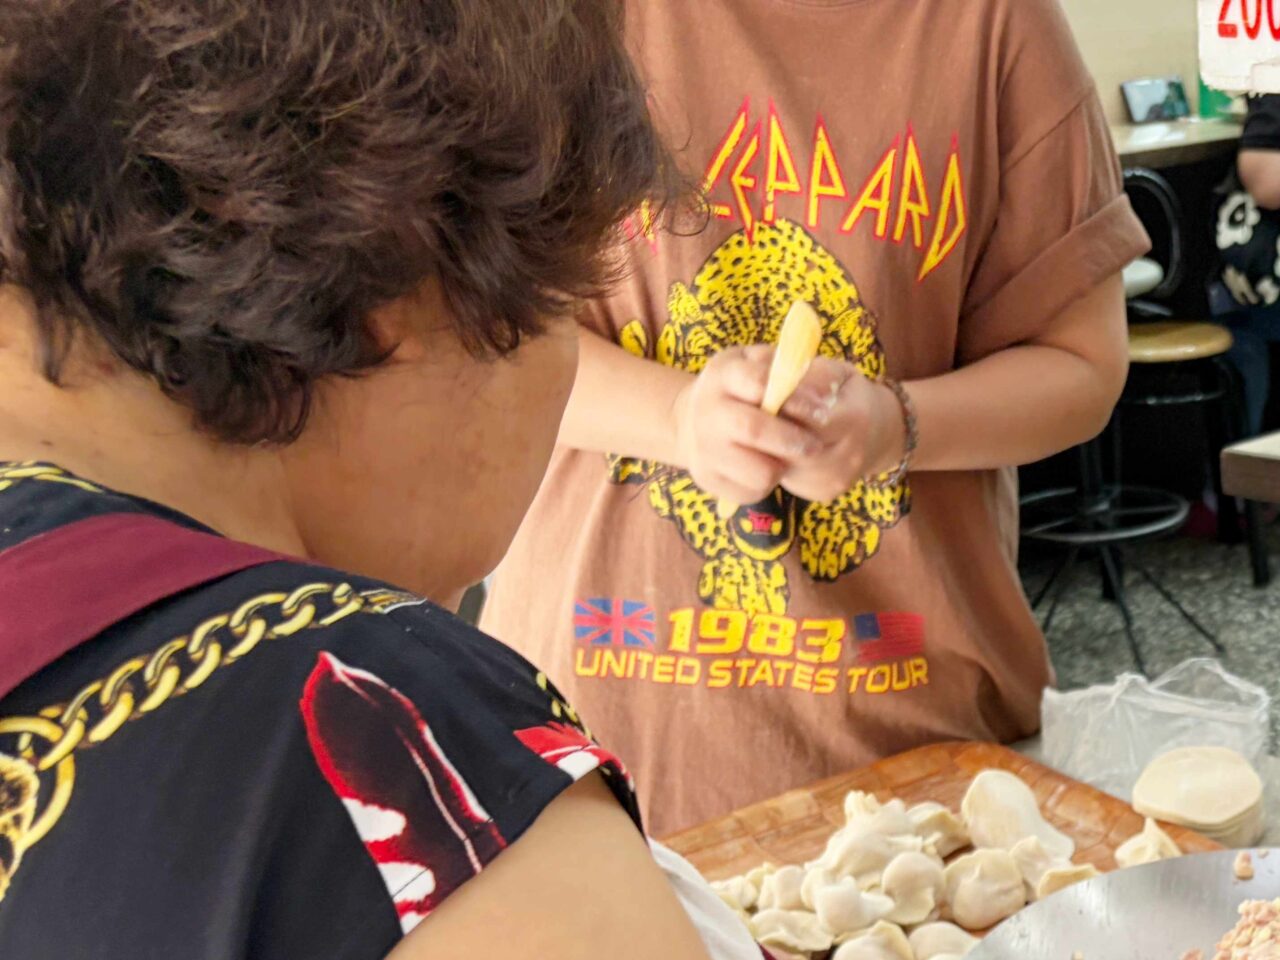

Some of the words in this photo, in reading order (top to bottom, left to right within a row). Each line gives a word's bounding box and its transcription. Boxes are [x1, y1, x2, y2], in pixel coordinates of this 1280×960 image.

[667, 607, 846, 664] 1983
[574, 647, 702, 686] UNITED
[706, 657, 840, 694] STATES
[846, 656, 930, 694] TOUR
